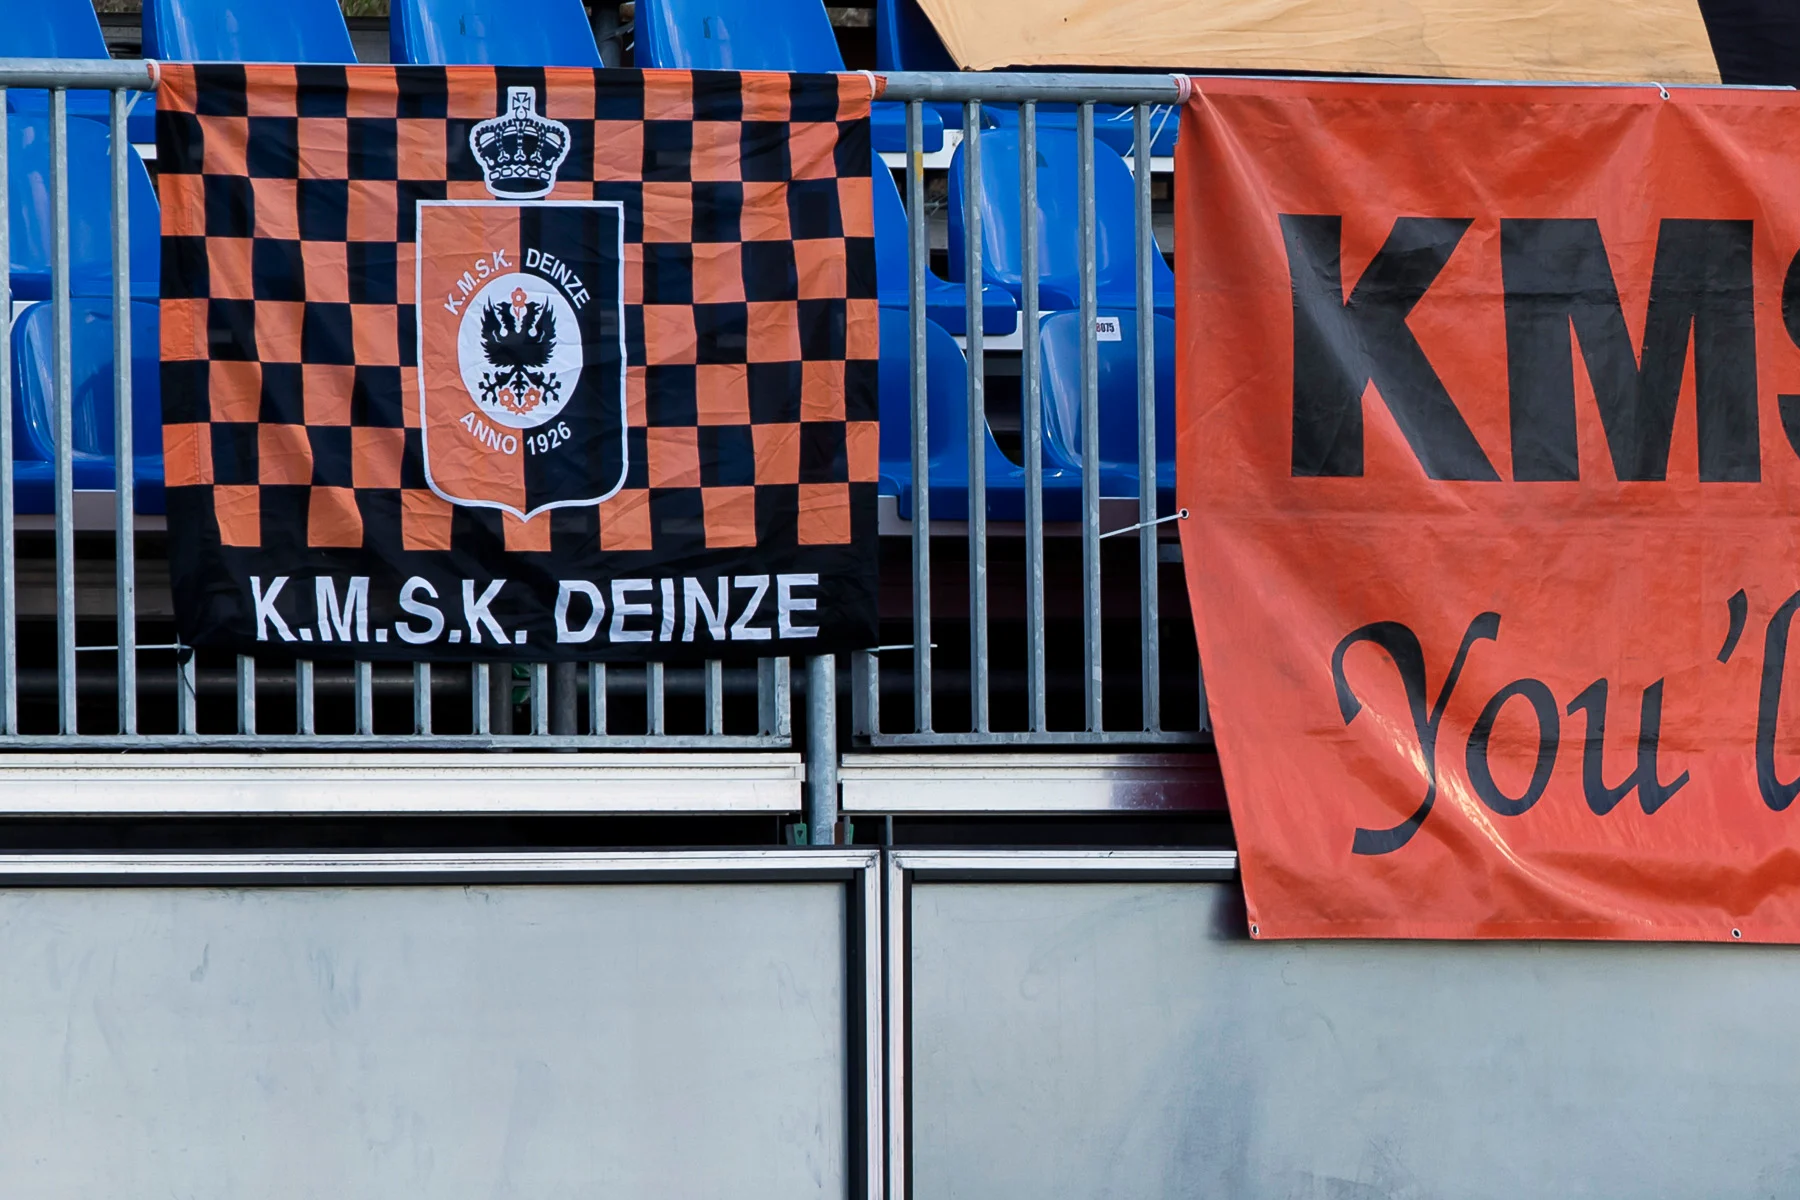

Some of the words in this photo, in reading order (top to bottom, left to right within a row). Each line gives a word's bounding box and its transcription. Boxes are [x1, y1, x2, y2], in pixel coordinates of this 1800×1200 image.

[444, 248, 513, 316] K.M.S.K.
[526, 248, 591, 310] DEINZE
[459, 411, 518, 455] ANNO
[526, 421, 572, 456] 1926
[250, 575, 528, 645] K.M.S.K.
[555, 573, 820, 644] DEINZE
